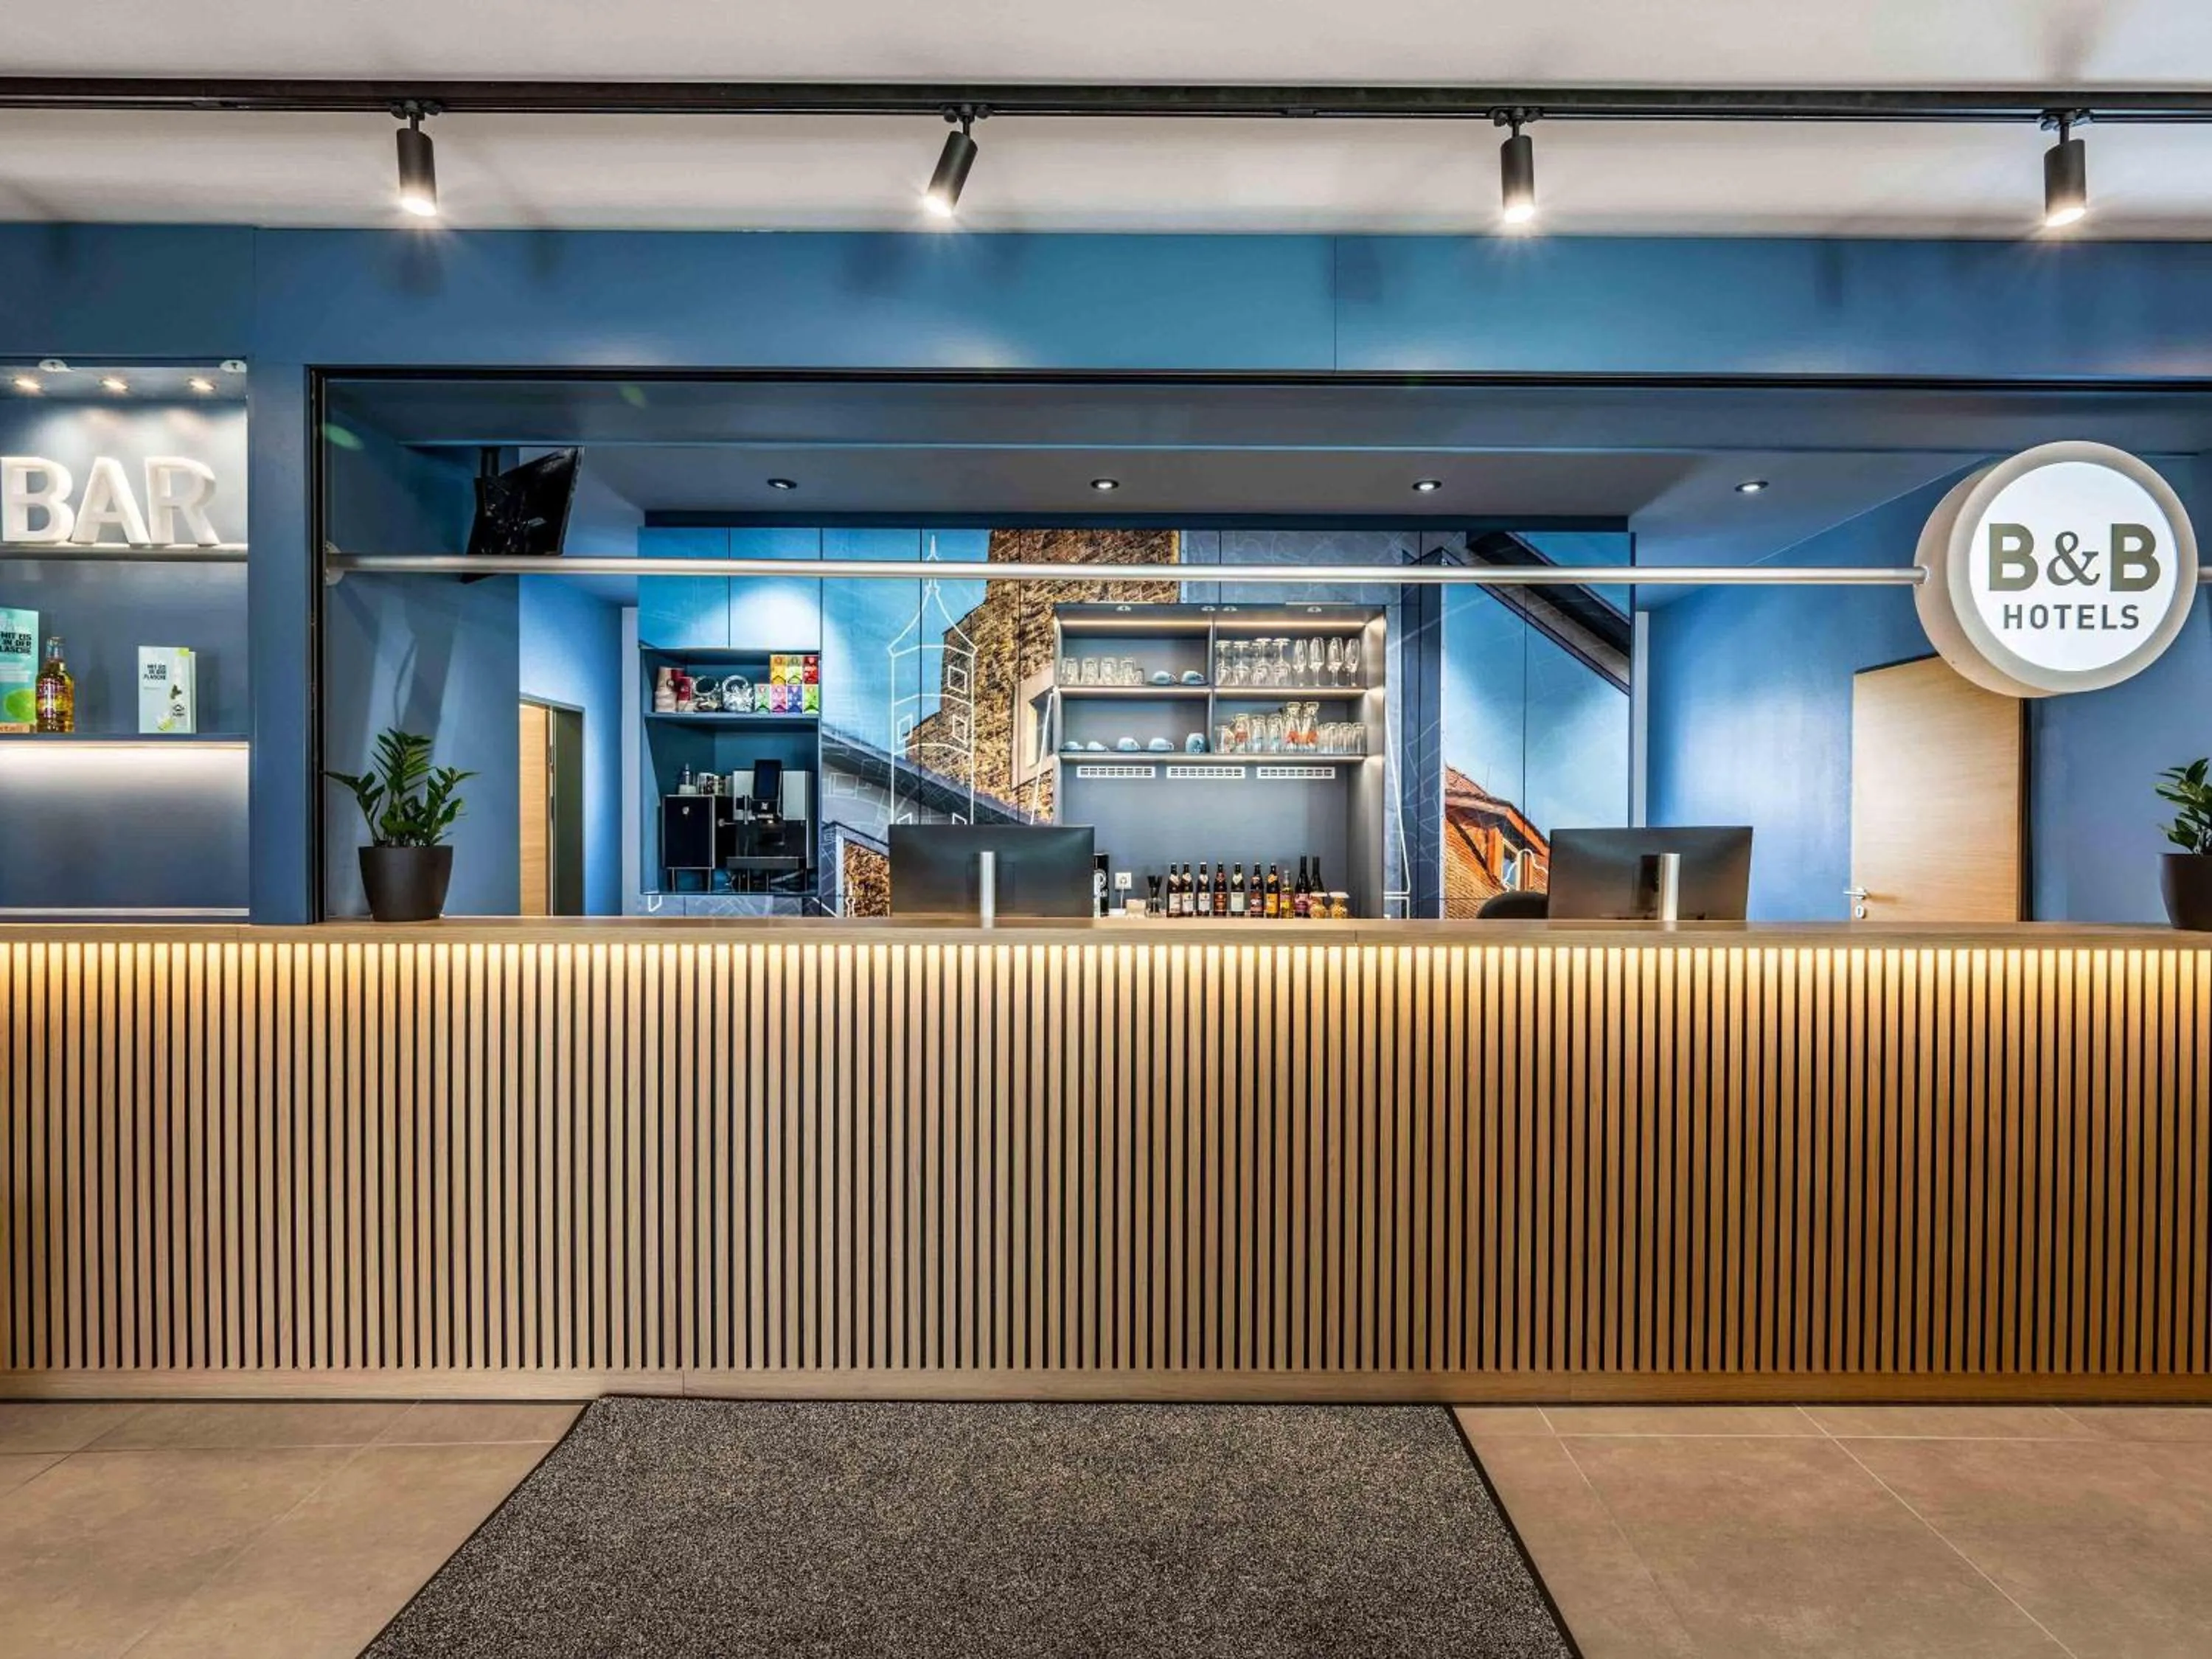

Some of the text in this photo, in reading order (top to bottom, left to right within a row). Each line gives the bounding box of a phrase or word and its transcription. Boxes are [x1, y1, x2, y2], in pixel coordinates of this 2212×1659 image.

[1, 456, 220, 545] BAR
[1989, 523, 2161, 592] B&B
[2003, 604, 2140, 630] HOTELS
[0, 645, 32, 655] LASCHE
